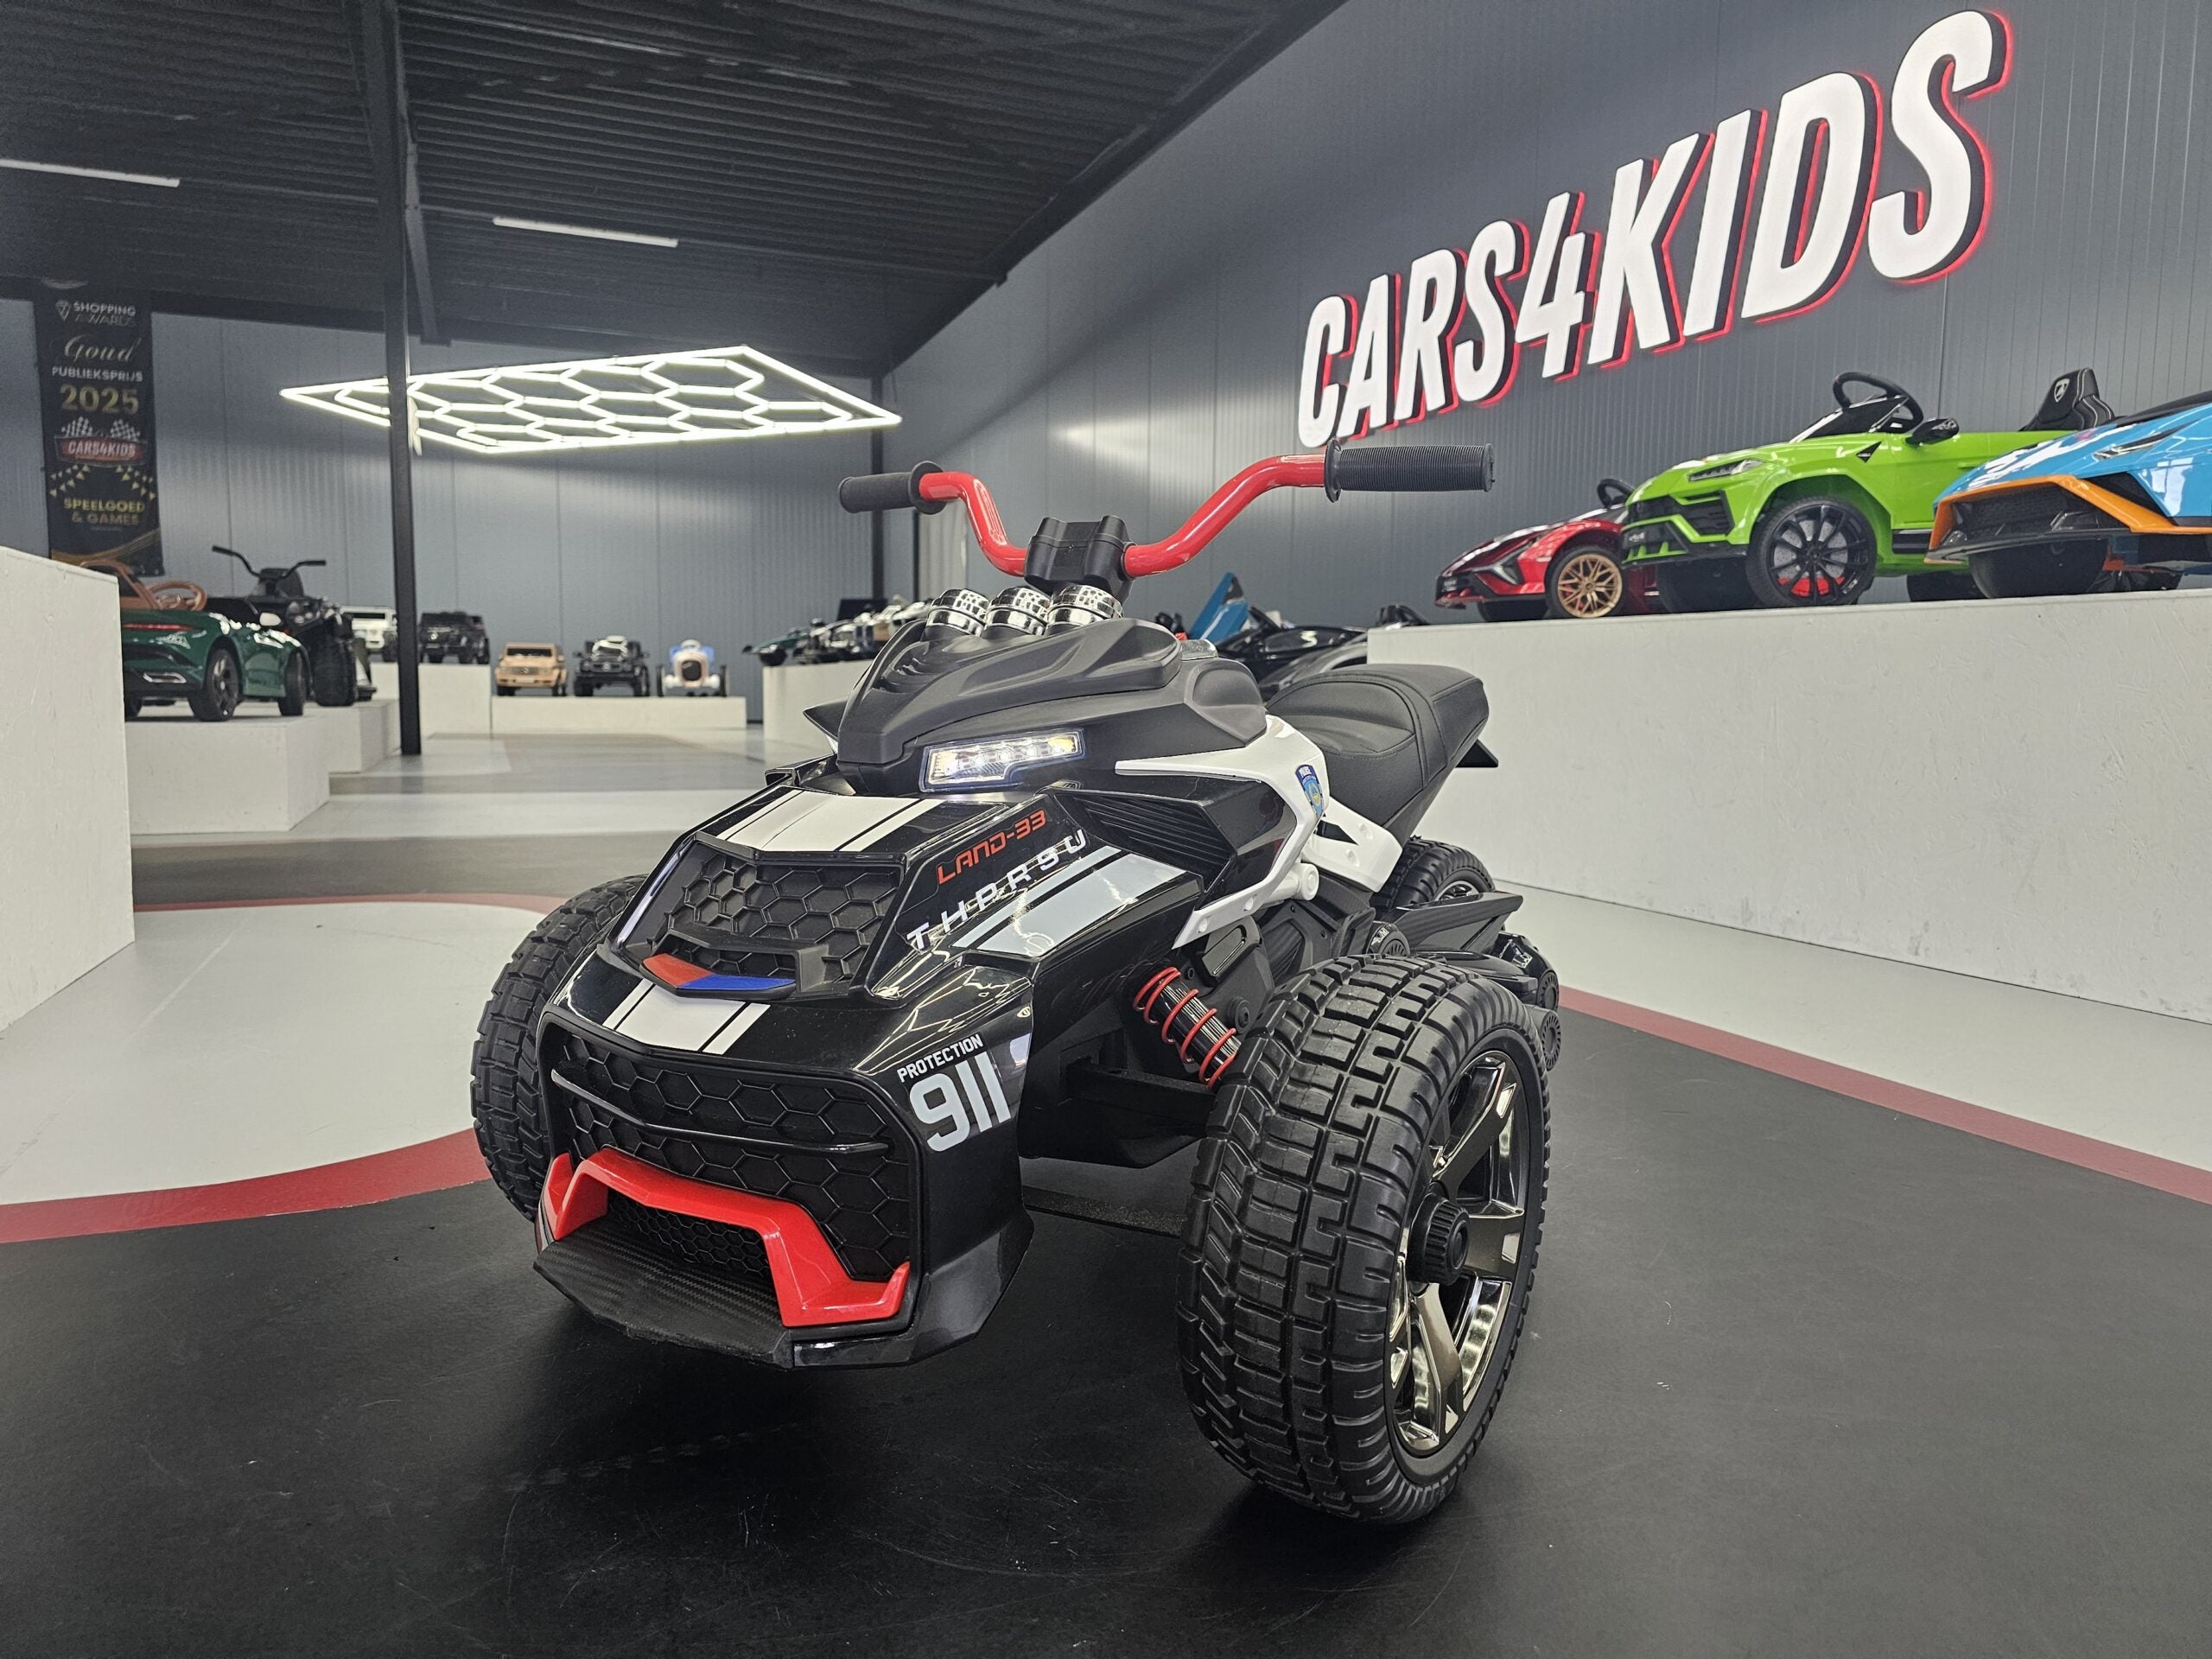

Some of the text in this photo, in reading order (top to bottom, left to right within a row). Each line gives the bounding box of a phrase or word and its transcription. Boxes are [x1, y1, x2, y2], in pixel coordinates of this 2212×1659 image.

[1297, 10, 2006, 448] CARS4KIDS
[73, 302, 137, 316] SHOPPING
[65, 334, 142, 363] Goud
[52, 366, 143, 382] PUBLIEKSPRIJS
[60, 385, 139, 414] 2025
[68, 440, 137, 457] CARS4KIDS
[64, 498, 145, 512] SPEELGOED
[87, 513, 139, 525] GAMES
[937, 809, 1046, 885] LAND-33
[897, 1033, 983, 1083] PROTECTION
[909, 1052, 1011, 1152] 911
